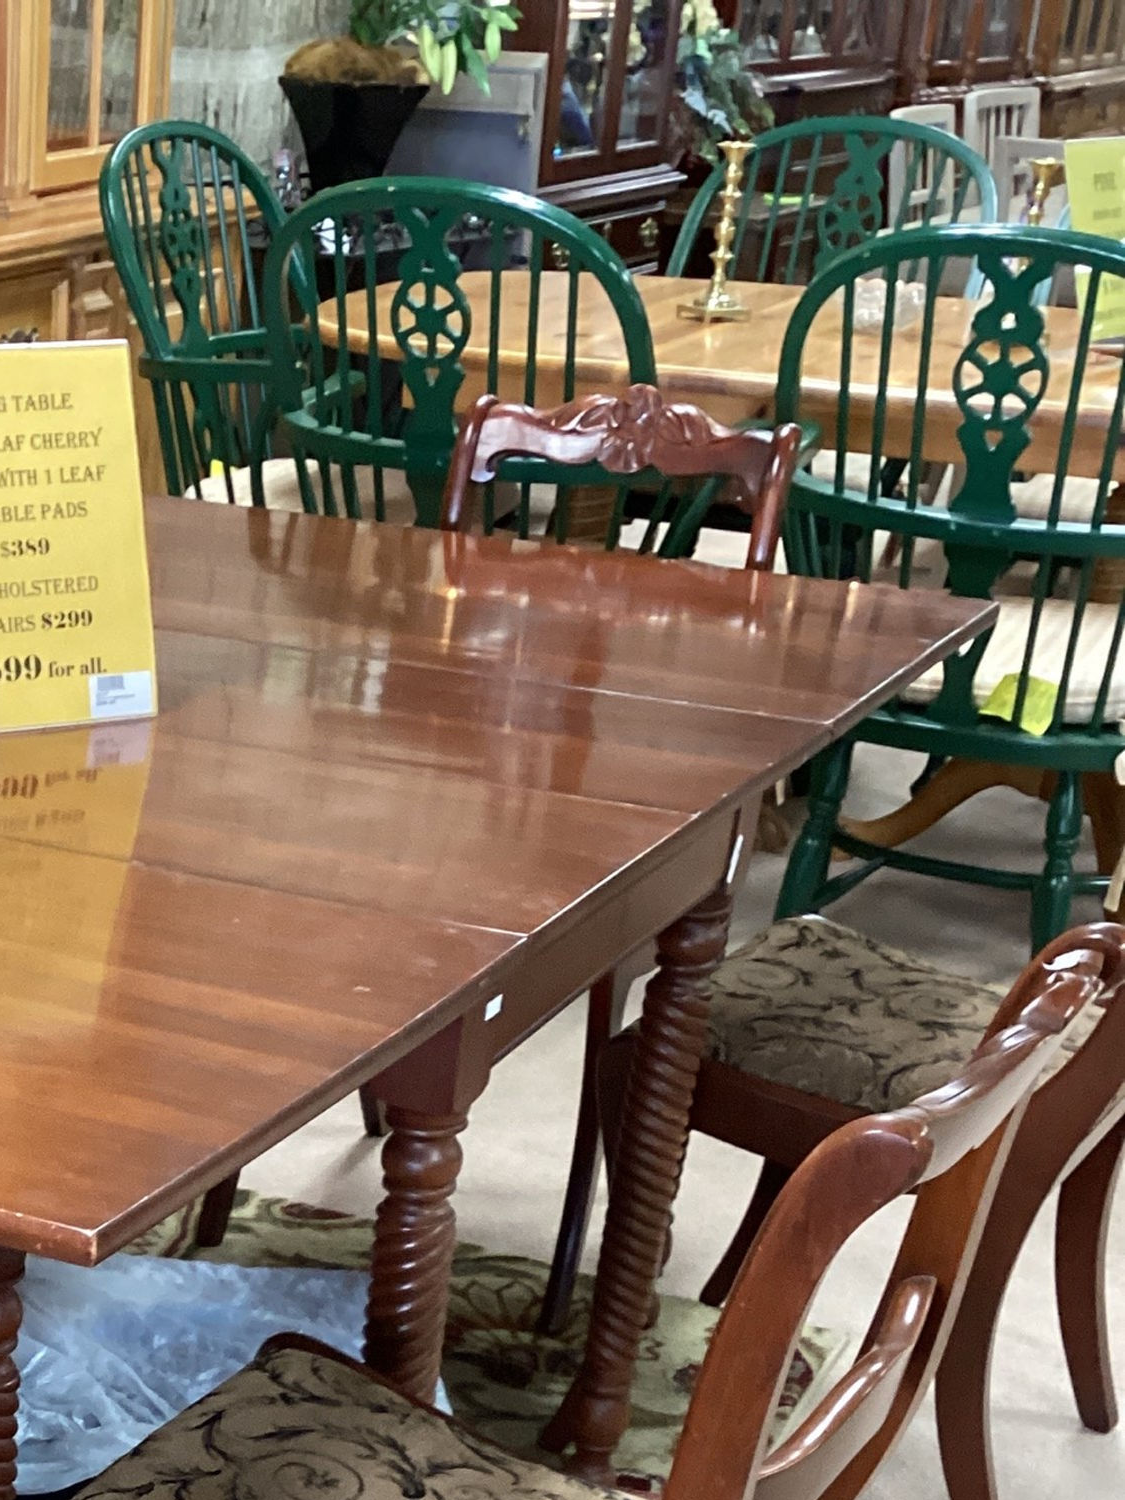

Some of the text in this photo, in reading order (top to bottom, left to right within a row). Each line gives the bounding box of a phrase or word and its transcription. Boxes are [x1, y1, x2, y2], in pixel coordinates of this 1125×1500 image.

[12, 393, 74, 412] TABLE
[30, 427, 103, 450] CHERRY
[44, 468, 53, 484] 1
[59, 464, 106, 484] LEAF
[40, 501, 88, 520] PADS
[0, 538, 50, 558] $389
[41, 609, 93, 630] $299
[48, 661, 75, 678] for
[79, 656, 107, 675] all.
